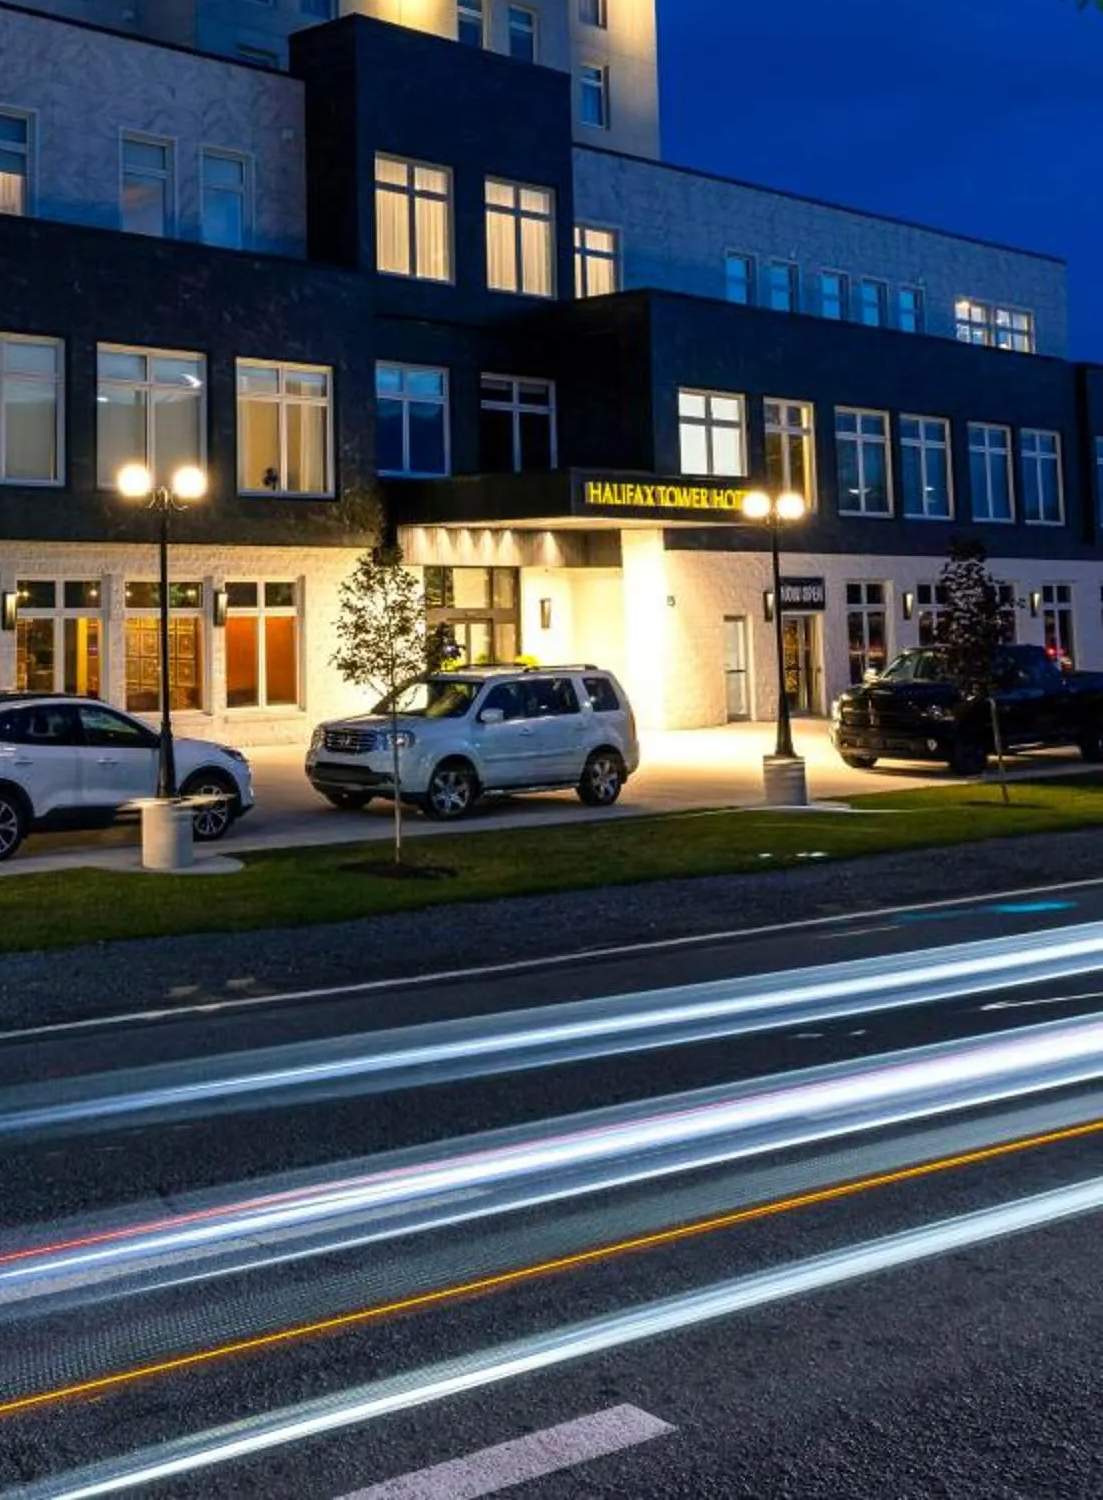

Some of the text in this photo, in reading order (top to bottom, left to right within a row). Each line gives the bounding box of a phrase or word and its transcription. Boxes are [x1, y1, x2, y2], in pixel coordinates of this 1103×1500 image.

[587, 481, 752, 509] HALIFAX TOWER HOT
